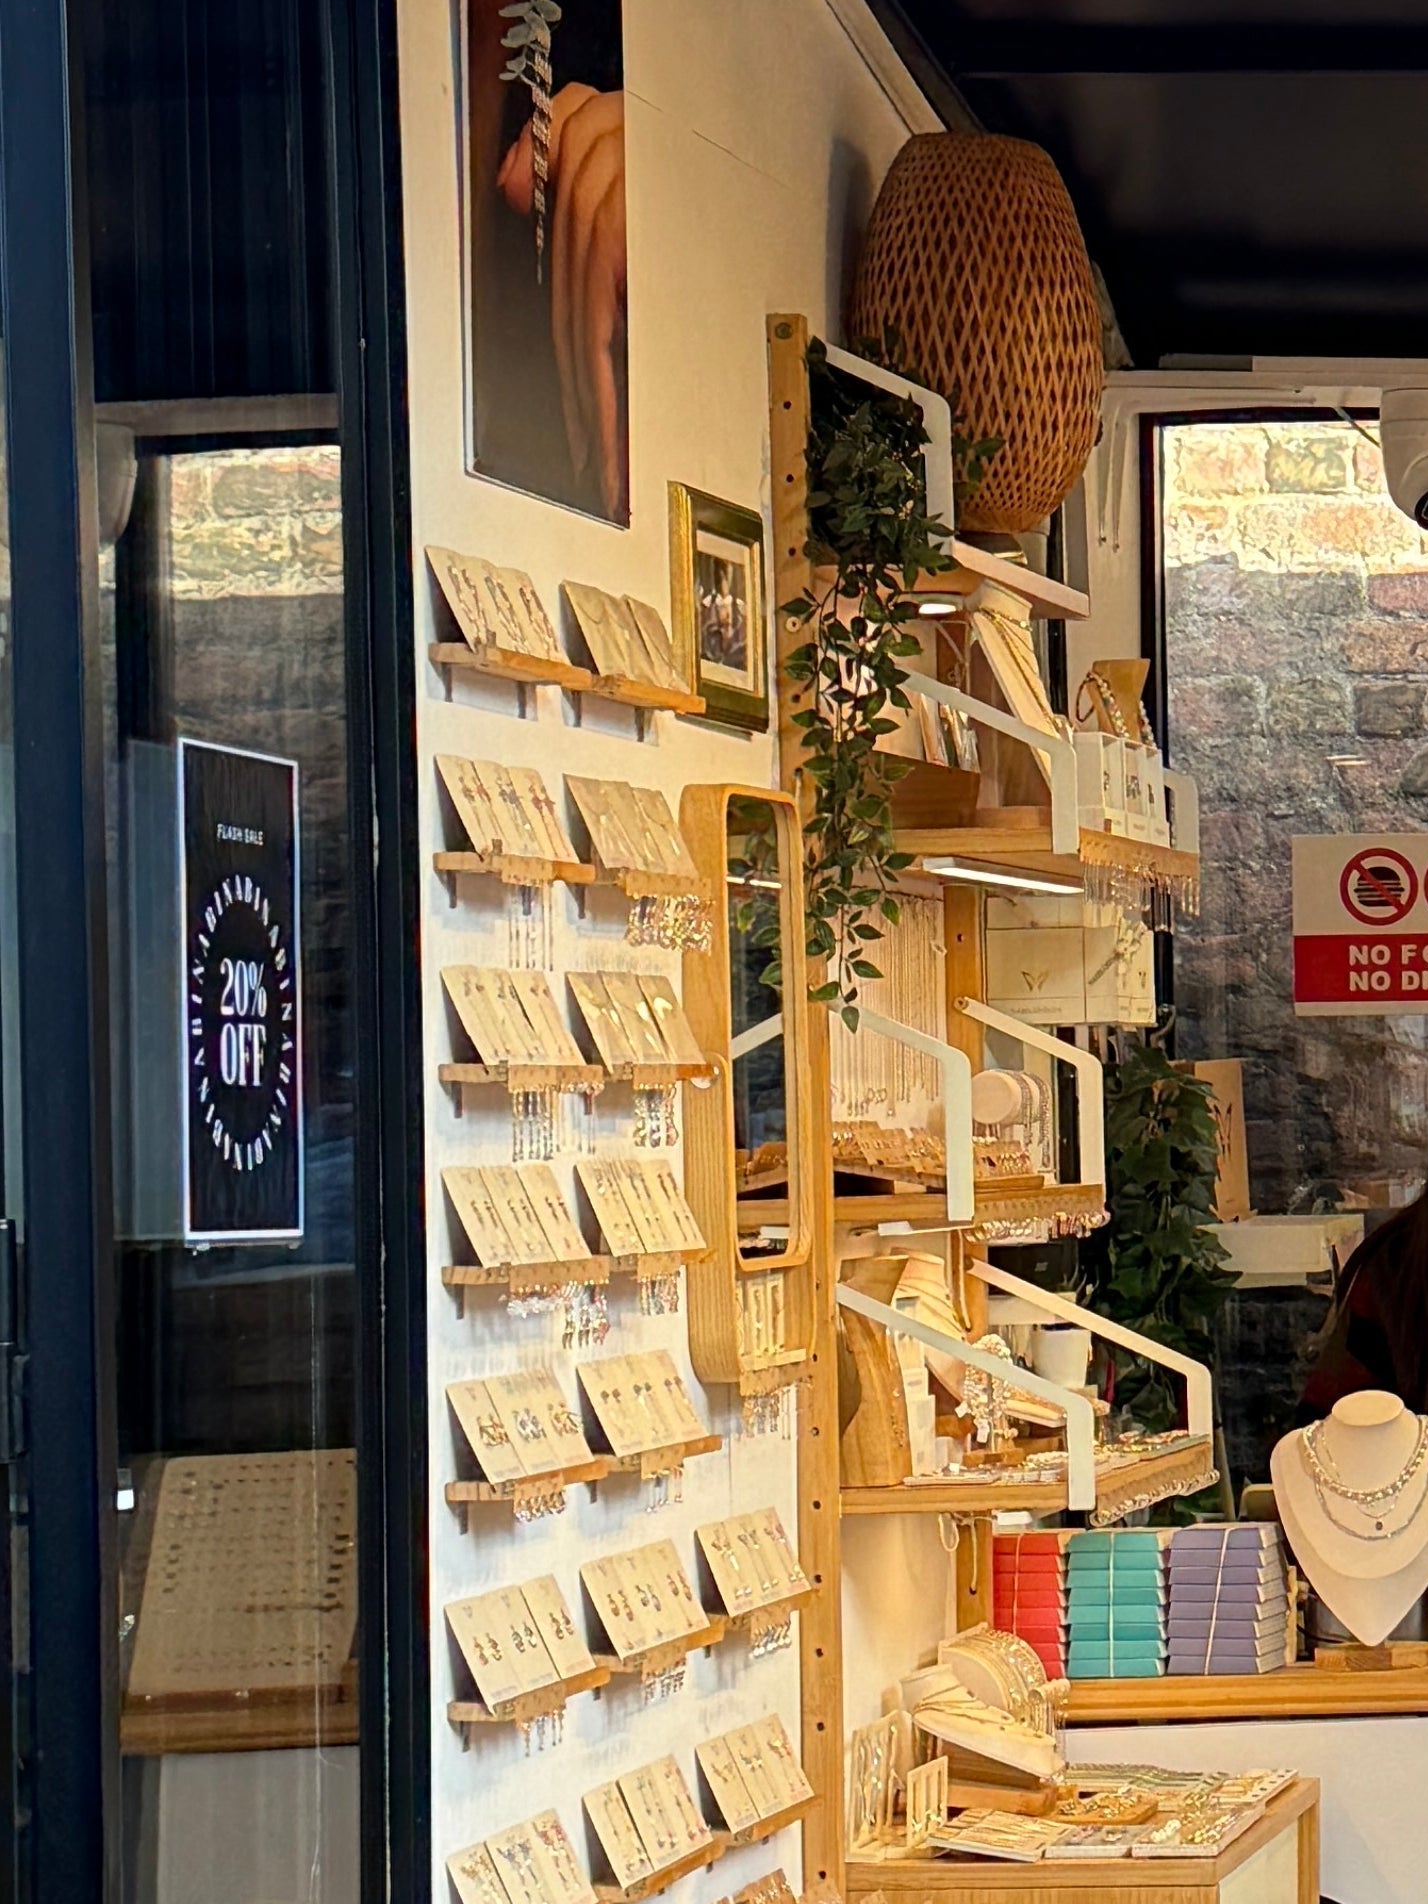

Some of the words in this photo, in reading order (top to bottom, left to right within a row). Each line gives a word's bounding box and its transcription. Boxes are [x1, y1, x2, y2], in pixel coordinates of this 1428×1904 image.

[1348, 944, 1391, 966] NO
[219, 956, 268, 1018] 20%
[1348, 970, 1391, 992] NO
[219, 1022, 268, 1087] OFF
